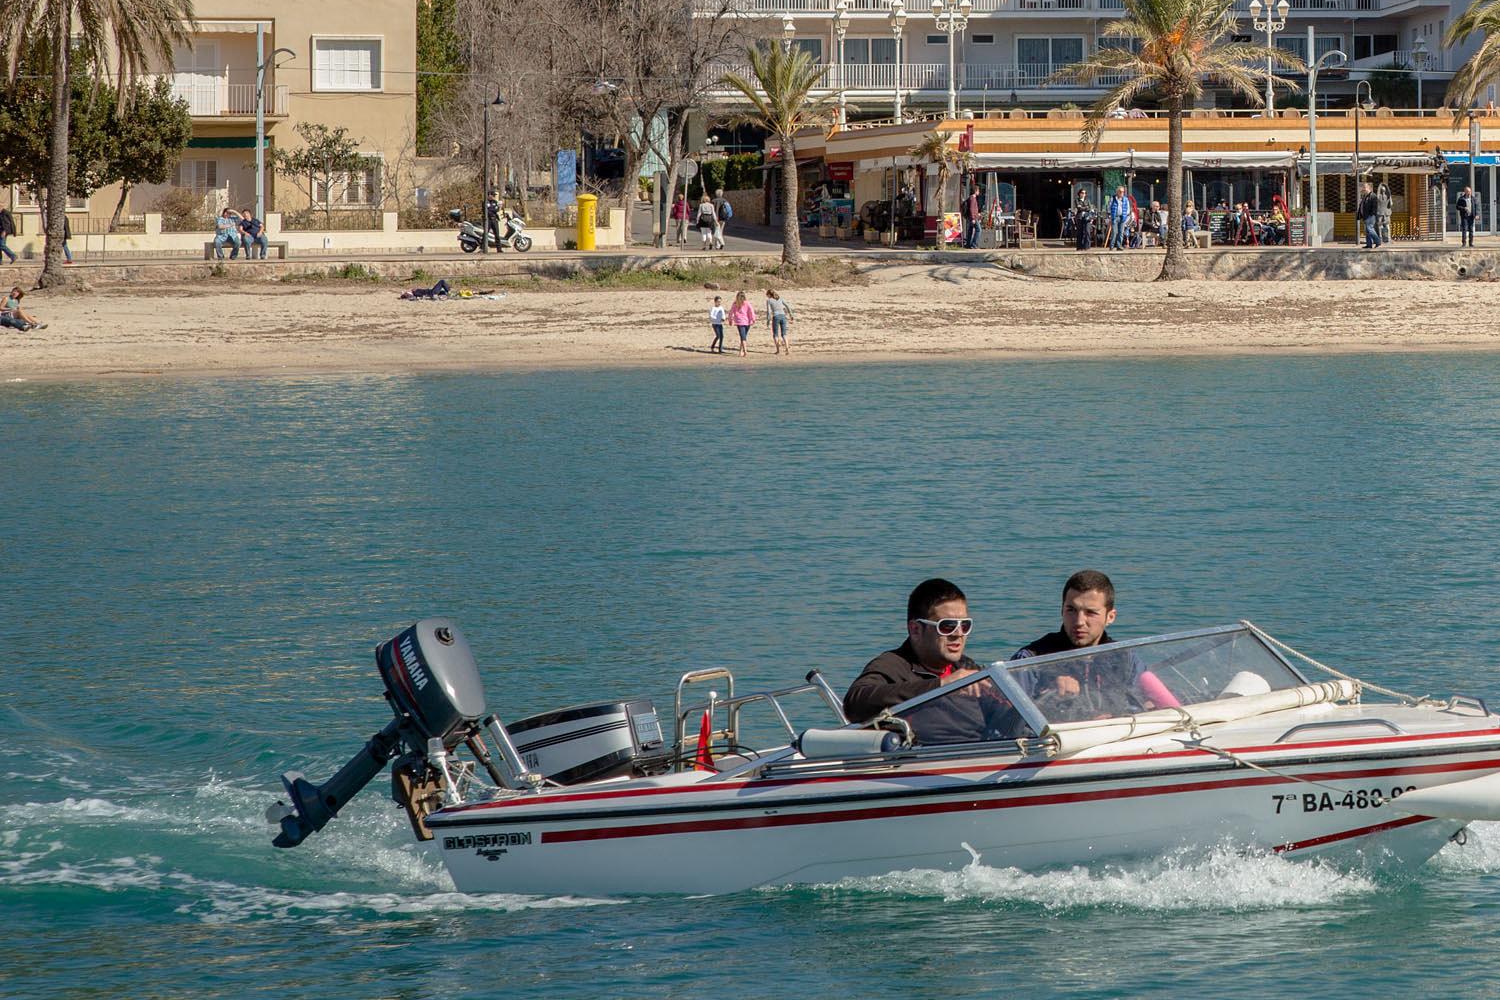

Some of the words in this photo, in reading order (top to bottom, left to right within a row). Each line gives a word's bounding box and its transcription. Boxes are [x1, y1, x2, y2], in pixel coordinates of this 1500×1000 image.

[400, 636, 429, 691] YAMAHA
[1302, 785, 1416, 813] BA-480-9
[443, 831, 532, 850] GLASTRON
